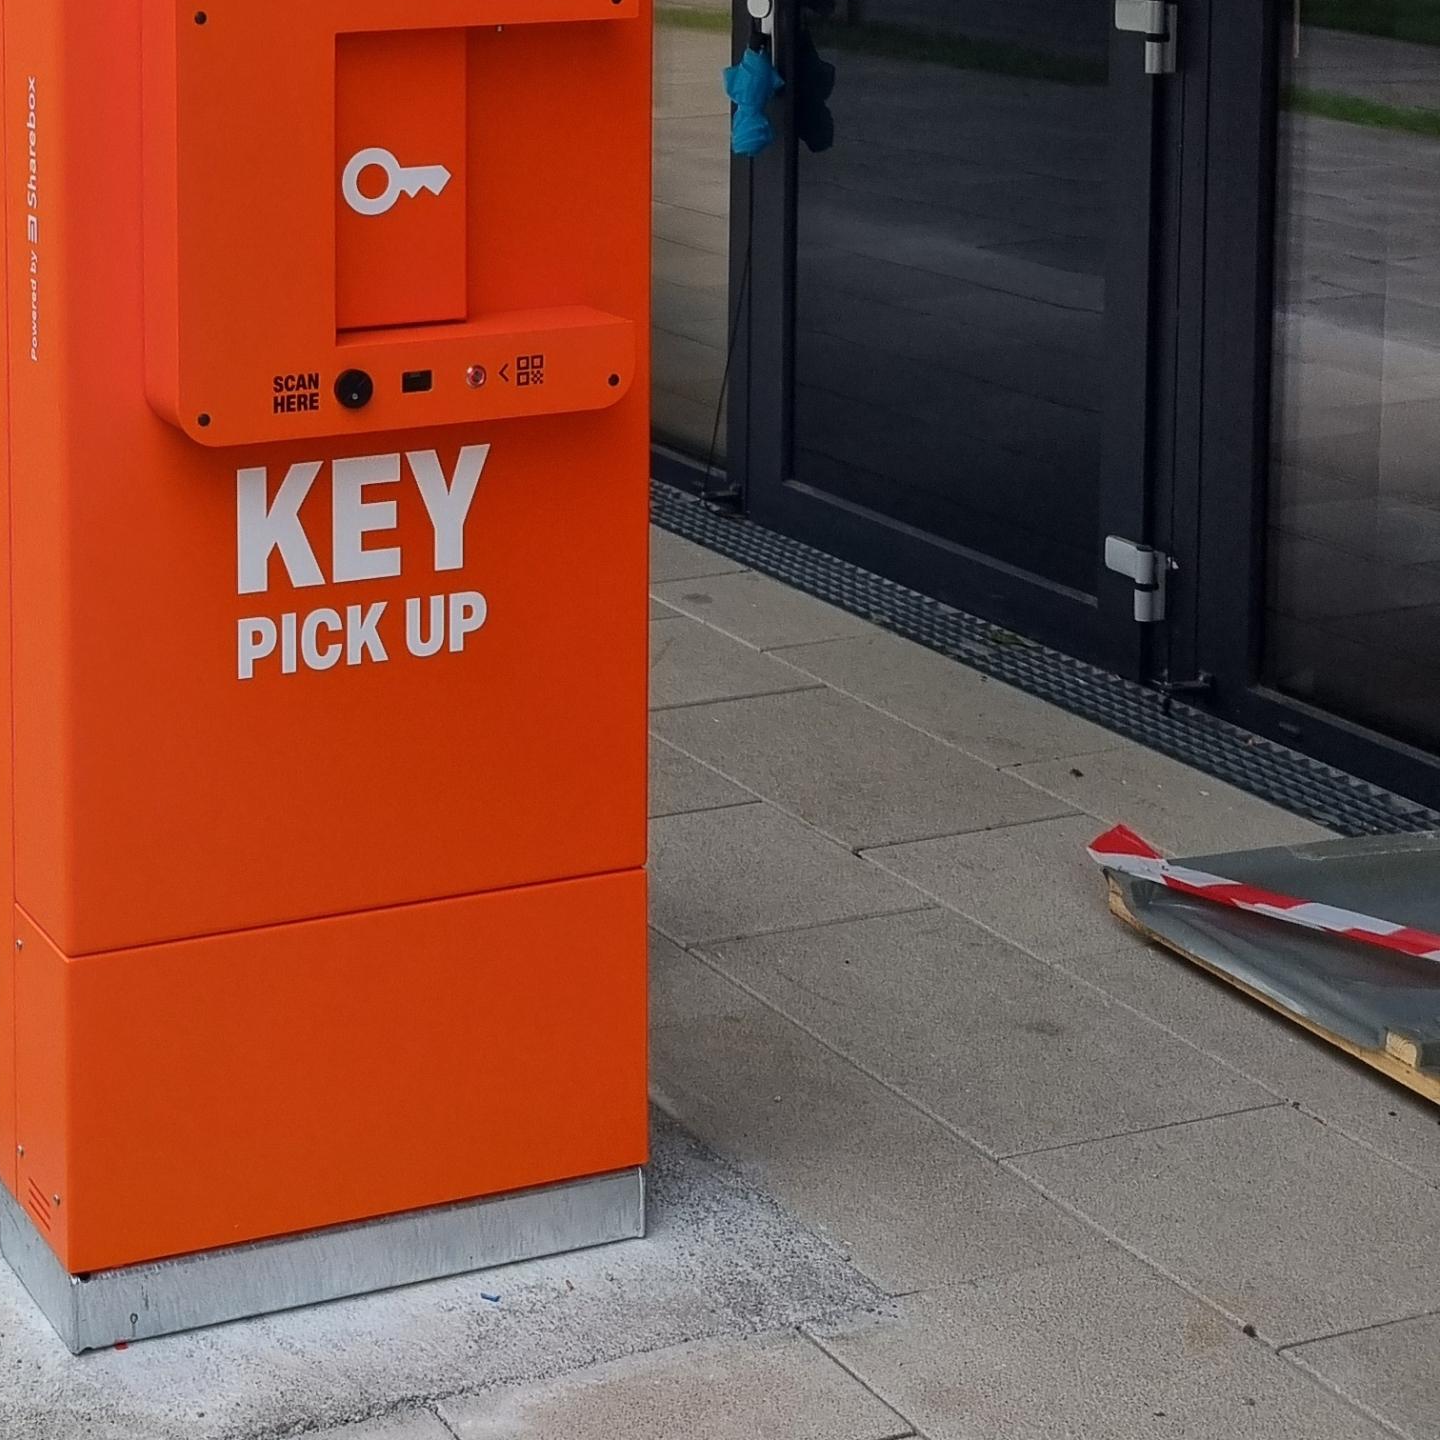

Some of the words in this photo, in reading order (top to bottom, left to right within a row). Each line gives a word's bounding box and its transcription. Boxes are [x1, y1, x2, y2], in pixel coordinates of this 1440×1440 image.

[27, 76, 37, 209] Sharebox
[30, 250, 38, 273] by
[30, 278, 38, 361] Powered
[273, 372, 320, 393] SCAN
[273, 392, 320, 414] HERE
[236, 443, 491, 596] KEY
[237, 600, 389, 680] PICK
[406, 591, 488, 658] UP
